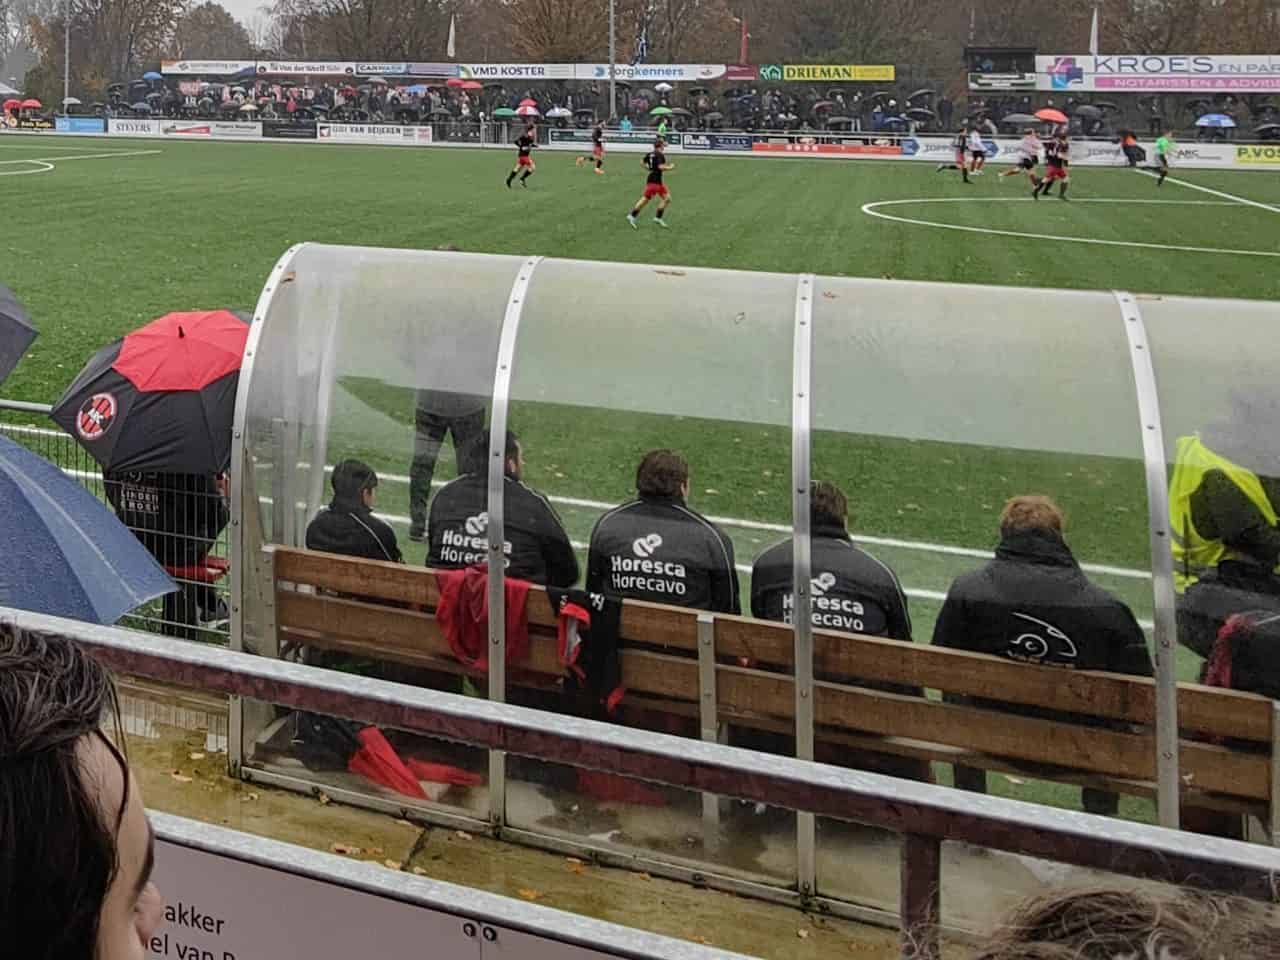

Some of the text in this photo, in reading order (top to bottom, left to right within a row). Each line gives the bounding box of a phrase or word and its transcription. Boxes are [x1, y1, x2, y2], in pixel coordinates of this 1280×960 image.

[472, 66, 545, 76] VMD KOSTER
[786, 67, 853, 79] DRIEMAN
[1094, 56, 1214, 73] KROES
[442, 529, 513, 554] Horesa
[611, 556, 686, 578] Horesca
[611, 573, 687, 595] Horecavo
[783, 593, 864, 615] Hresca
[164, 902, 225, 935] akker
